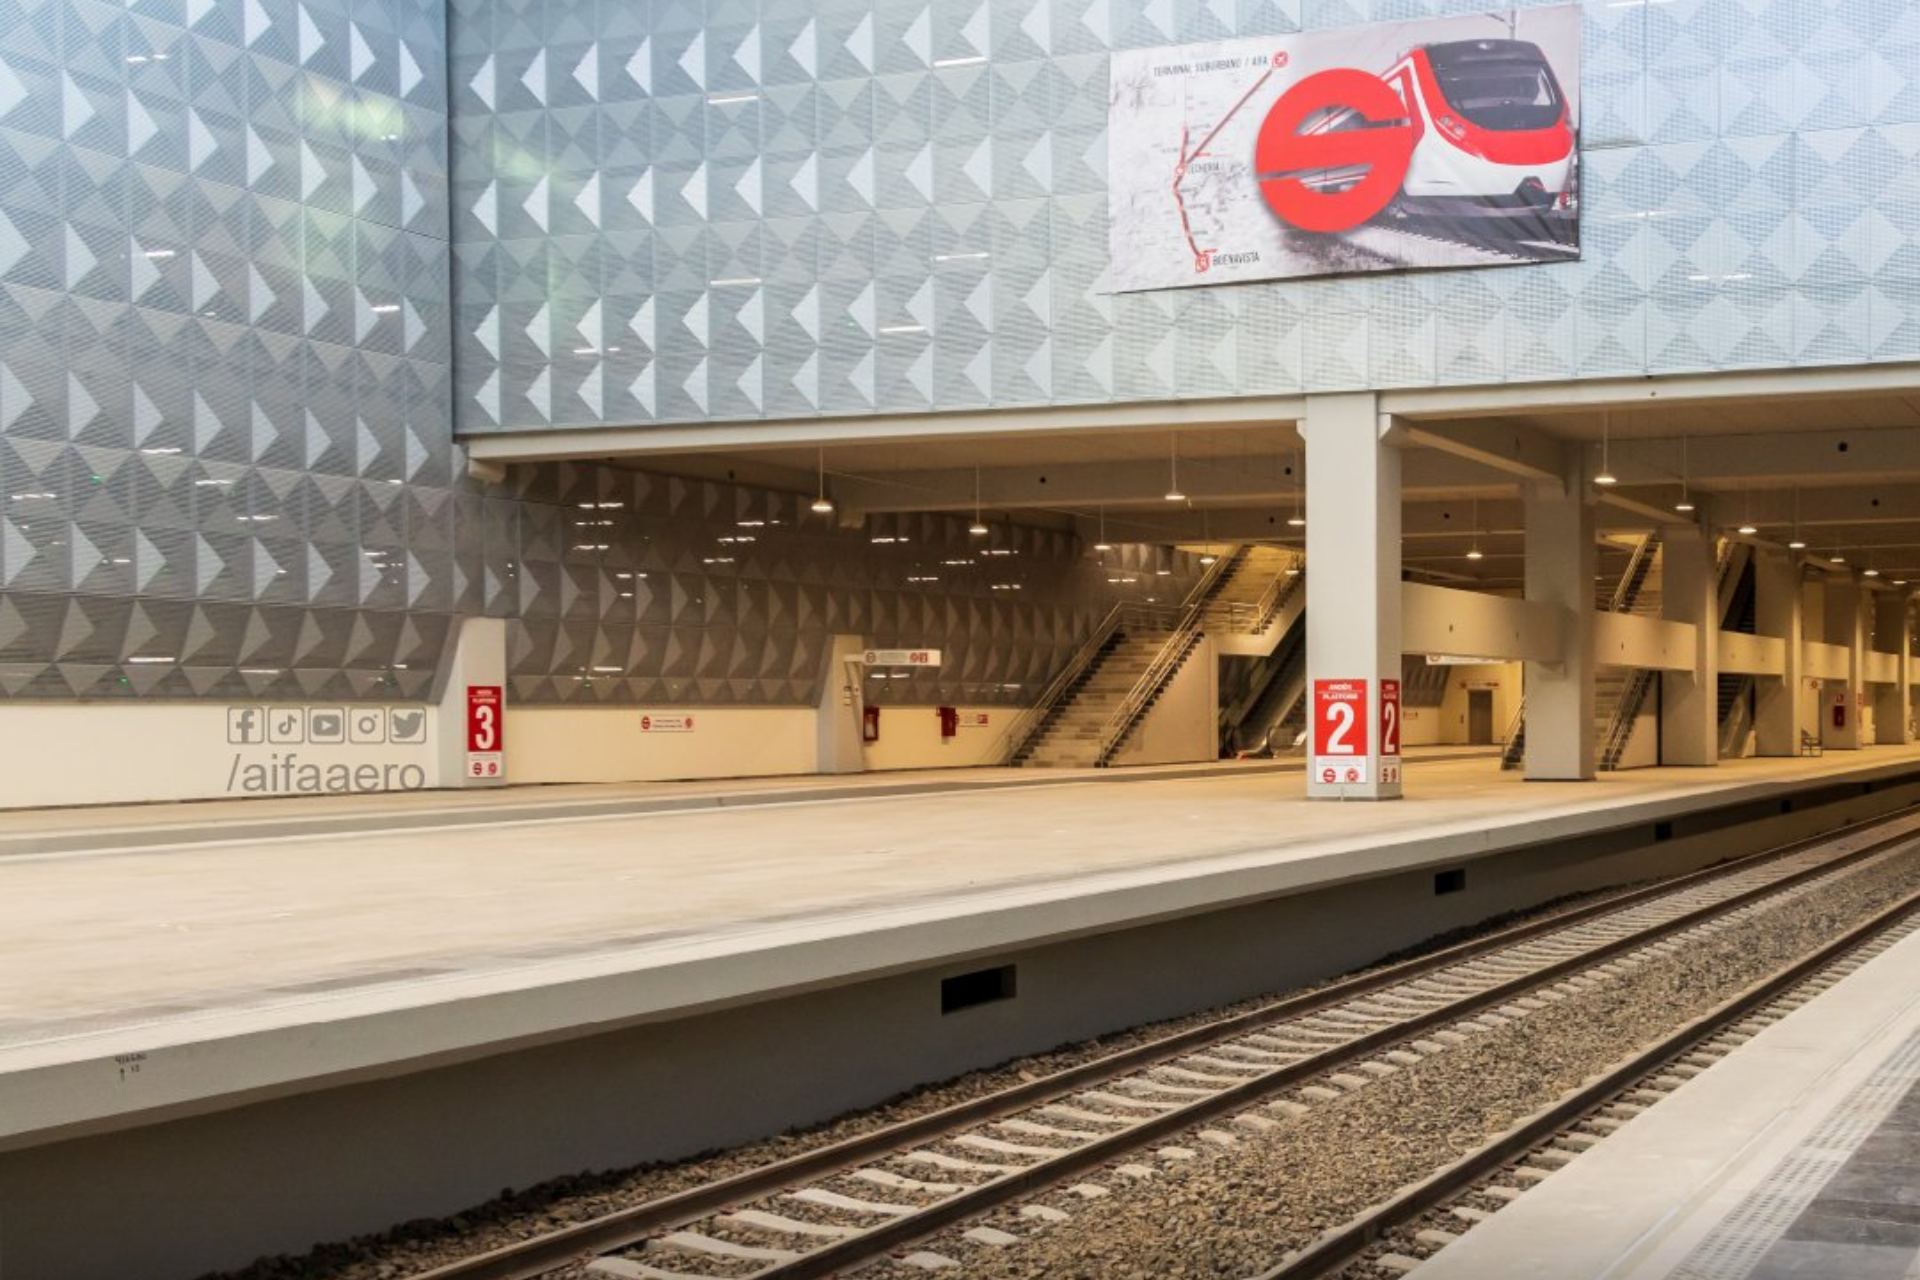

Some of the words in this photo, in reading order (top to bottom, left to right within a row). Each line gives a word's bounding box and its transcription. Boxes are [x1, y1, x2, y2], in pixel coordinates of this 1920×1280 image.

[1212, 251, 1260, 266] BUENAVISTA
[475, 705, 495, 750] 3
[1326, 701, 1355, 754] 2
[1384, 701, 1396, 753] 2
[226, 753, 426, 792] /aifaaero
